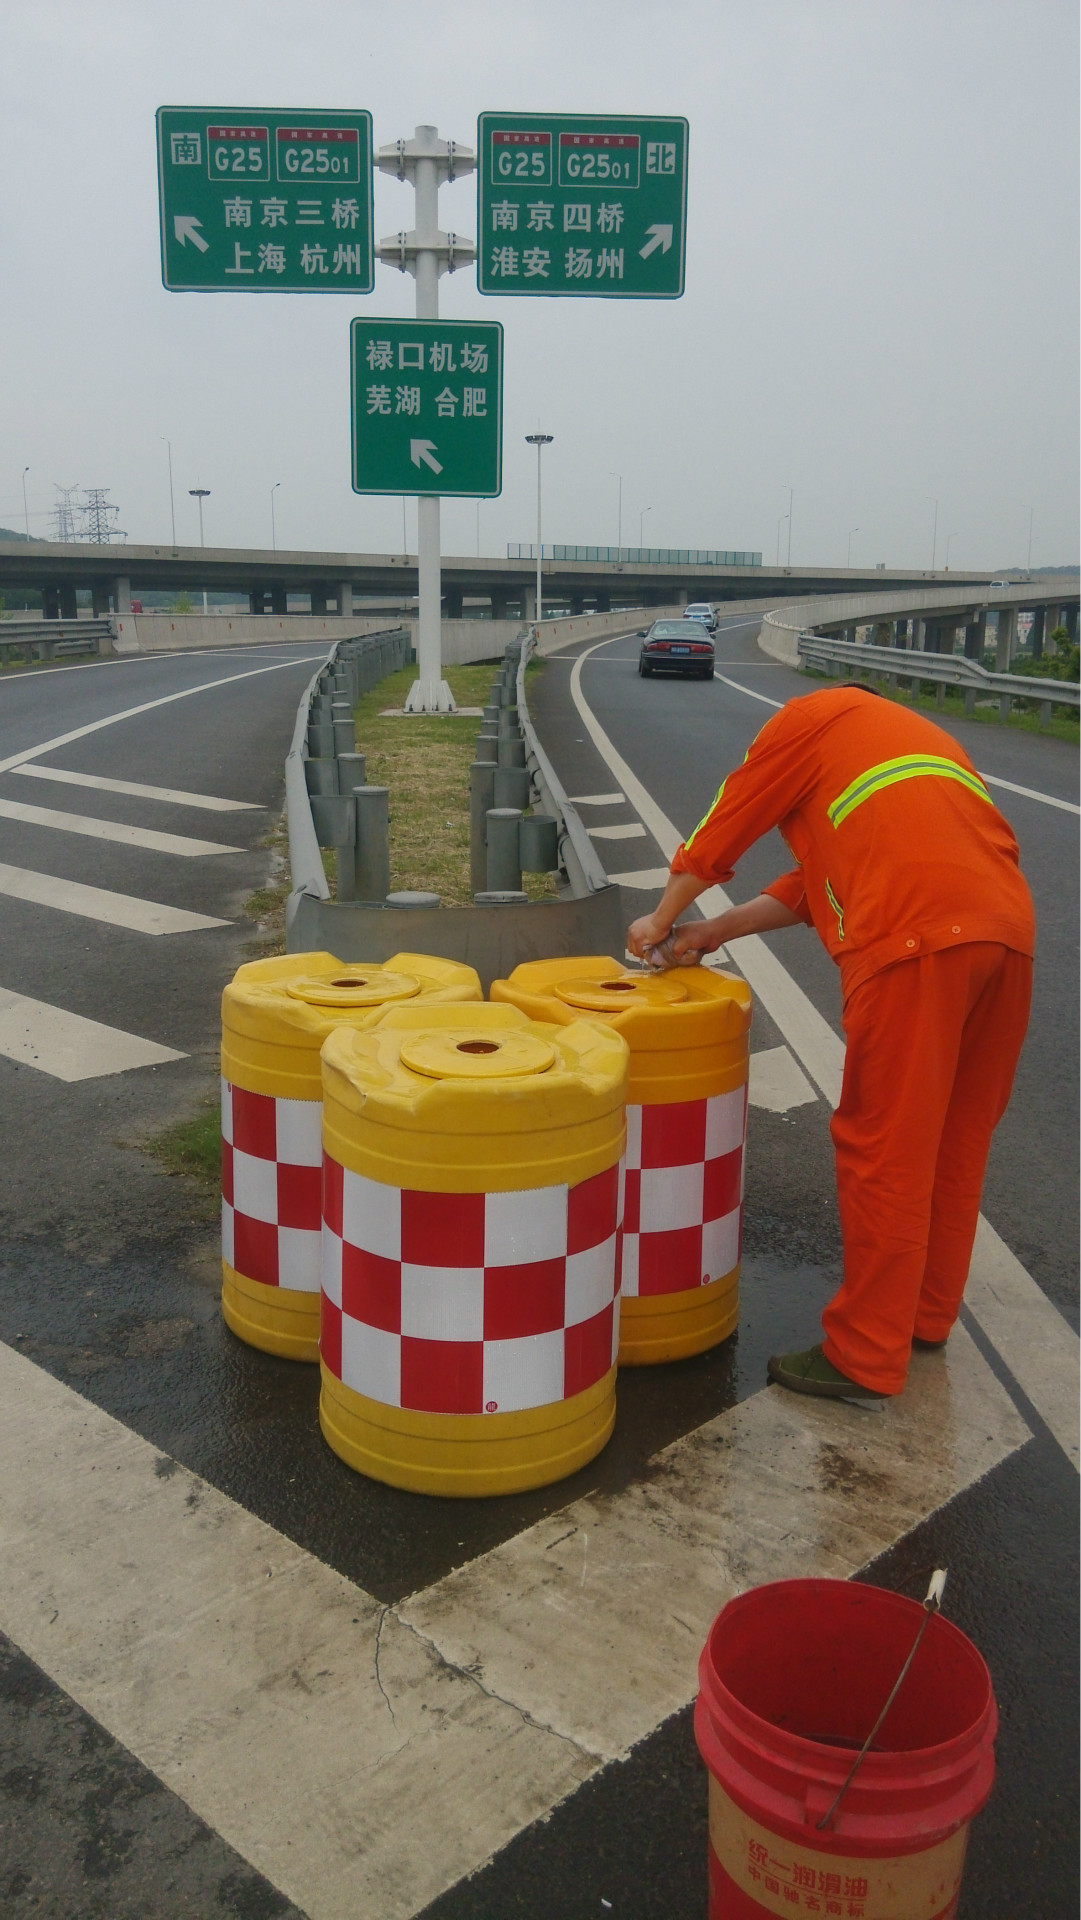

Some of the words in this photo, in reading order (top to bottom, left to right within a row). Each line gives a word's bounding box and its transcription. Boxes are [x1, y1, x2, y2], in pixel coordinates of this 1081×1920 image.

[172, 134, 200, 164] 南
[215, 147, 263, 172] G25
[285, 148, 349, 174] G2501
[499, 152, 545, 177] G25
[647, 143, 675, 173] 北
[567, 153, 630, 179] G2501
[223, 196, 360, 229] 南京三桥
[490, 200, 625, 234] 南京四桥
[225, 242, 286, 274] 上海
[300, 243, 361, 275] 杭州
[490, 246, 551, 278] 淮安
[564, 247, 625, 279] 扬州
[366, 340, 489, 374] 禄口机场
[366, 384, 421, 416] 芜湖
[434, 387, 488, 418] 合肥
[749, 1838, 868, 1898] 统一润滑油
[748, 1865, 865, 1918] 中国驰名商标
